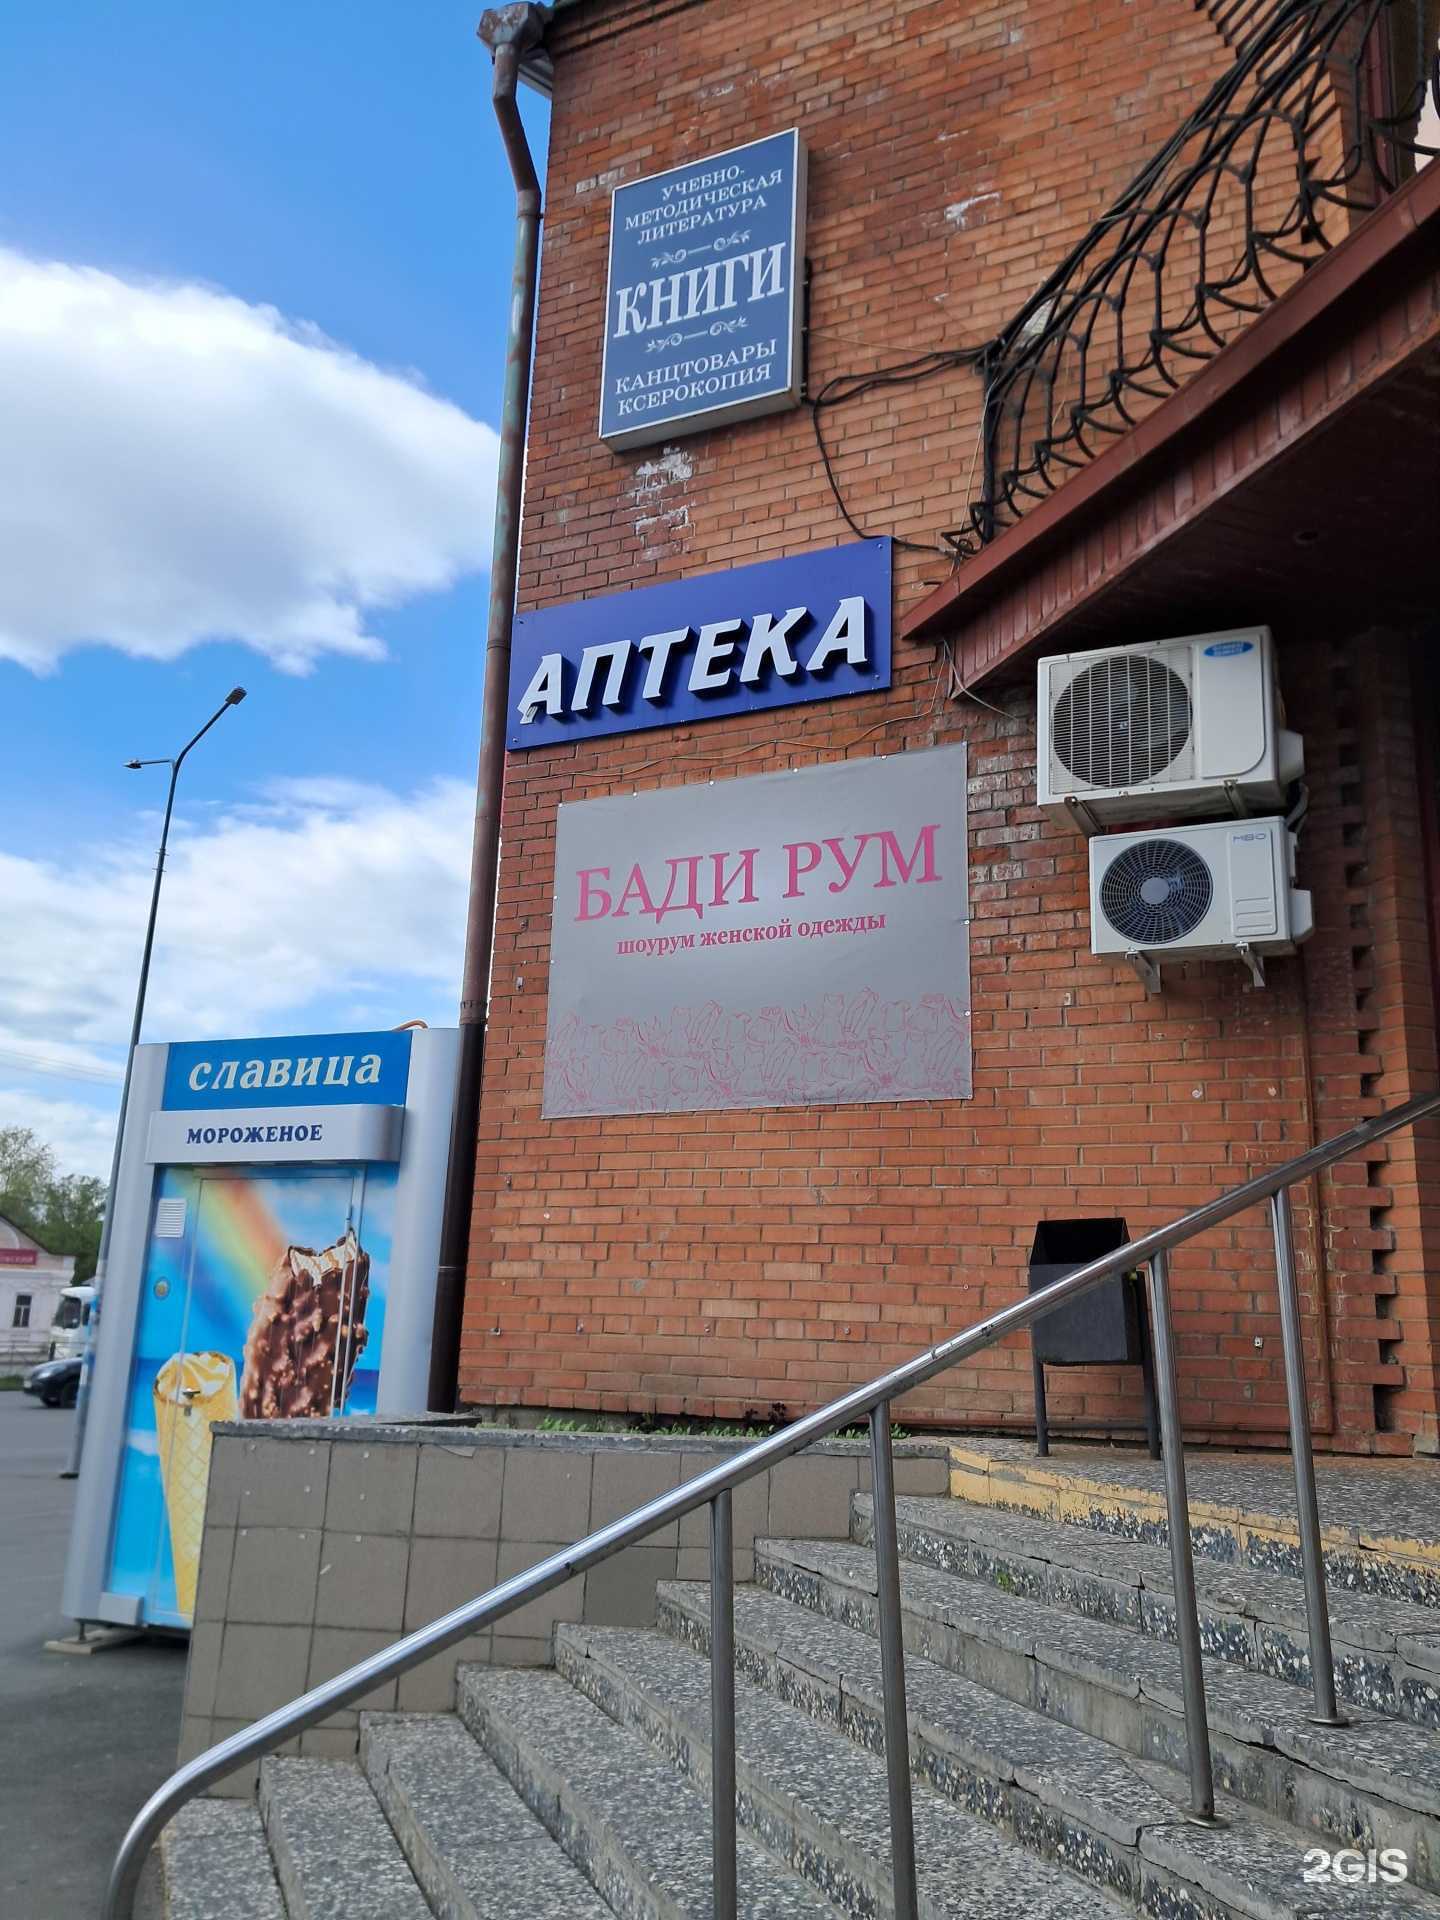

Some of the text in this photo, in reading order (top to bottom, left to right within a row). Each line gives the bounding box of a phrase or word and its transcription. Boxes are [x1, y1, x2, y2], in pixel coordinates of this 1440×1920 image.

[624, 169, 783, 231] МЕТОДИЧЕСКАЯ
[662, 165, 745, 201] УЧЕБНО-
[637, 194, 767, 245] ЛИТЕРАТУРА
[613, 242, 786, 339] КНИГИ
[615, 339, 777, 395] КАНЦТОВАРЫ
[617, 363, 771, 417] КСЕРОКОПИЯ
[517, 596, 868, 725] АПТЕКА
[574, 824, 943, 924] БАДИ РУМ
[616, 914, 886, 956] шоурум женской одежды
[186, 1124, 323, 1144] МОРОЖЕНОЕ
